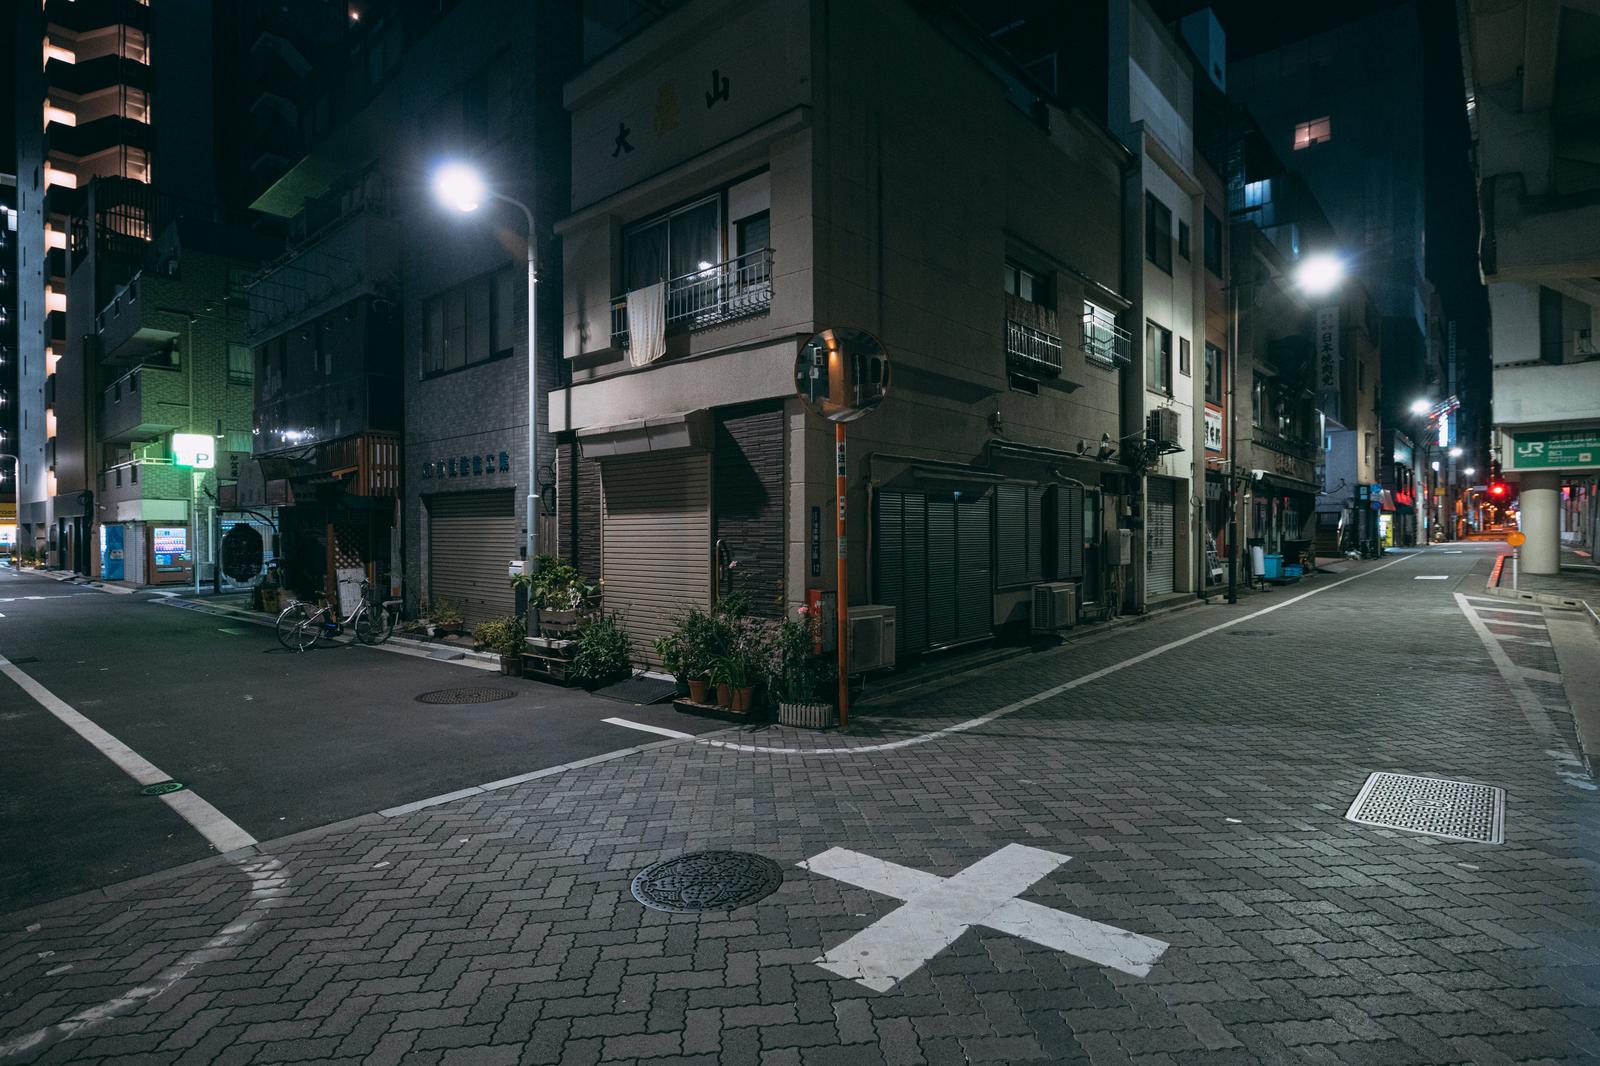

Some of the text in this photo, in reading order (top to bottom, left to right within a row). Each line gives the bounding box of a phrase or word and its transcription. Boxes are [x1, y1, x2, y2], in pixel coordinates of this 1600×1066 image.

[611, 69, 730, 158] 大 山
[1518, 442, 1544, 453] JR
